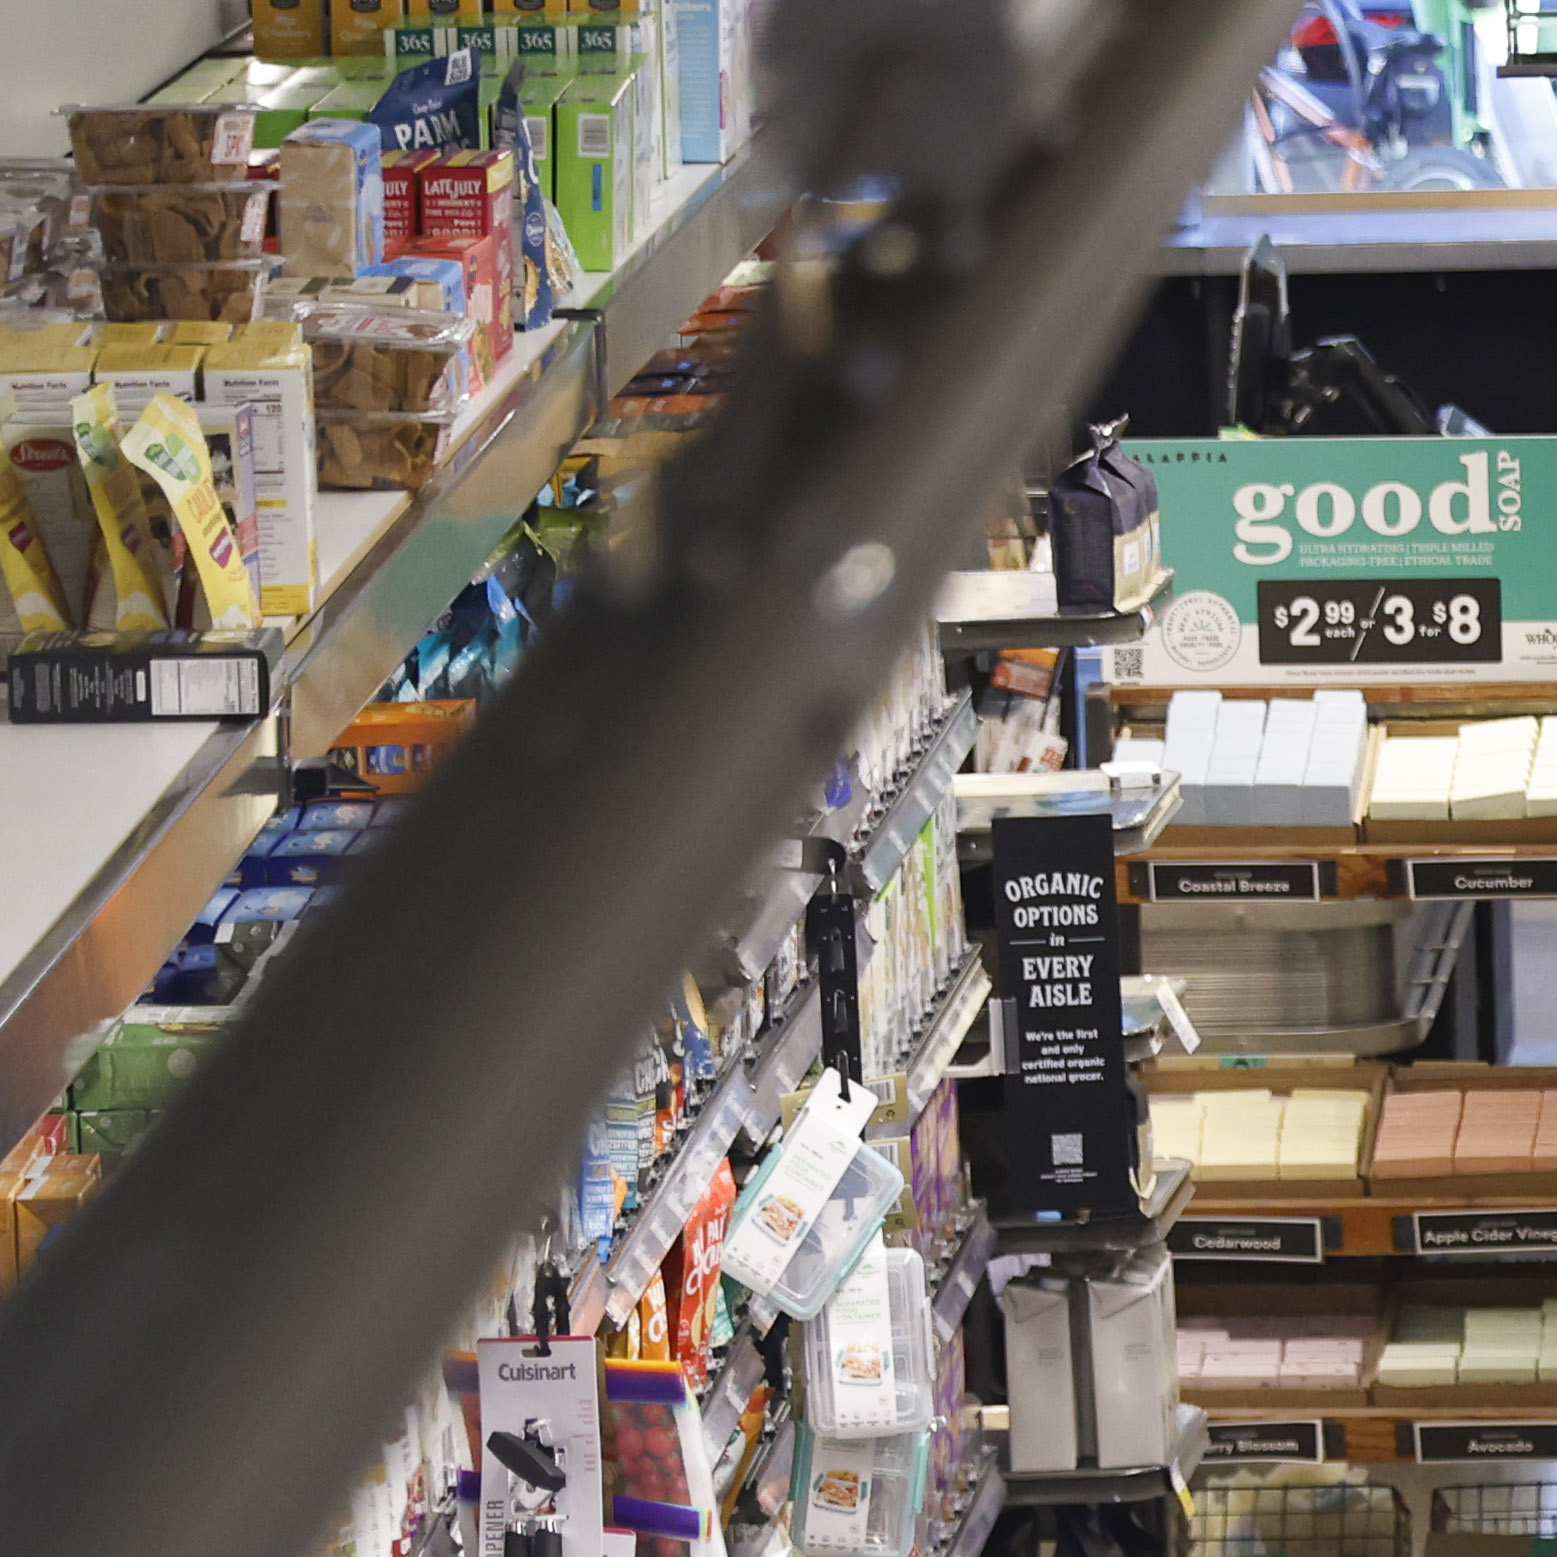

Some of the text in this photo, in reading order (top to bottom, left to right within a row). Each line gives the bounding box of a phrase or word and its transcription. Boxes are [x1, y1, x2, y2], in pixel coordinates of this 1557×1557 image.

[1498, 449, 1522, 532] SOAP
[1232, 450, 1498, 566] good
[1383, 594, 1415, 646] 3
[1418, 624, 1442, 638] for
[1432, 593, 1482, 645] $8
[1324, 627, 1356, 639] each
[1004, 871, 1105, 902] ORGANIC
[1179, 879, 1291, 893] Coastal Breeze
[1454, 875, 1534, 890] Cucumber
[1013, 904, 1099, 928] OPTIONS
[1049, 932, 1066, 948] in
[1021, 954, 1094, 981] EVERY
[1028, 982, 1093, 1008] AISLE
[1025, 1028, 1098, 1042] We're the first
[1040, 1044, 1085, 1056] and only
[1022, 1057, 1106, 1071] certified organic
[1024, 1072, 1104, 1084] national grocer.
[1192, 1235, 1282, 1251] Cedarwood
[1424, 1229, 1468, 1245] Apple
[1470, 1225, 1513, 1242] Cider
[498, 1362, 577, 1382] Cuisinart
[1238, 1439, 1299, 1453] Blossom
[1467, 1439, 1534, 1454] Avocado
